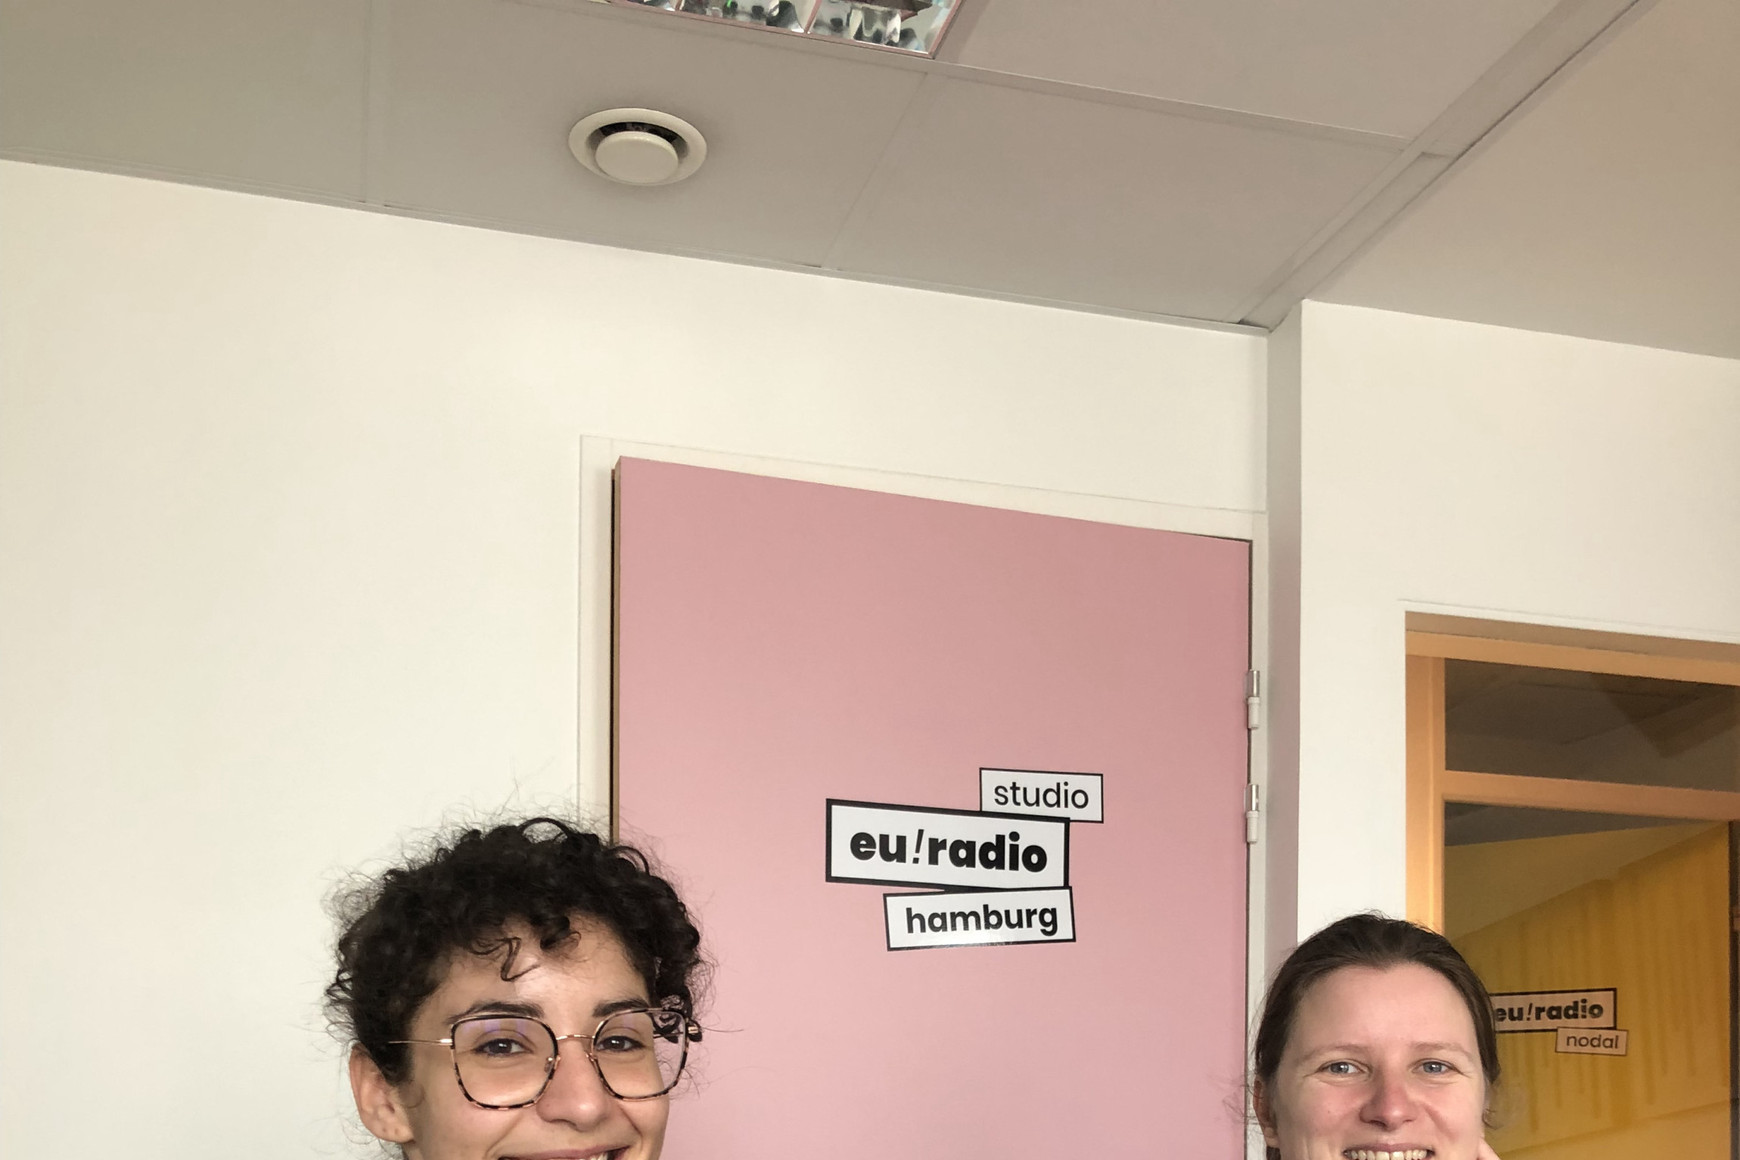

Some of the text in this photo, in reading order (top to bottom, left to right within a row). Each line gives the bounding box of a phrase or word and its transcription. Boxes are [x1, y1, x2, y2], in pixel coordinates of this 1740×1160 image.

[994, 781, 1089, 810] studio
[850, 829, 1048, 873] eu!radio
[905, 904, 1058, 936] hamburg
[1566, 1033, 1620, 1050] nodal
